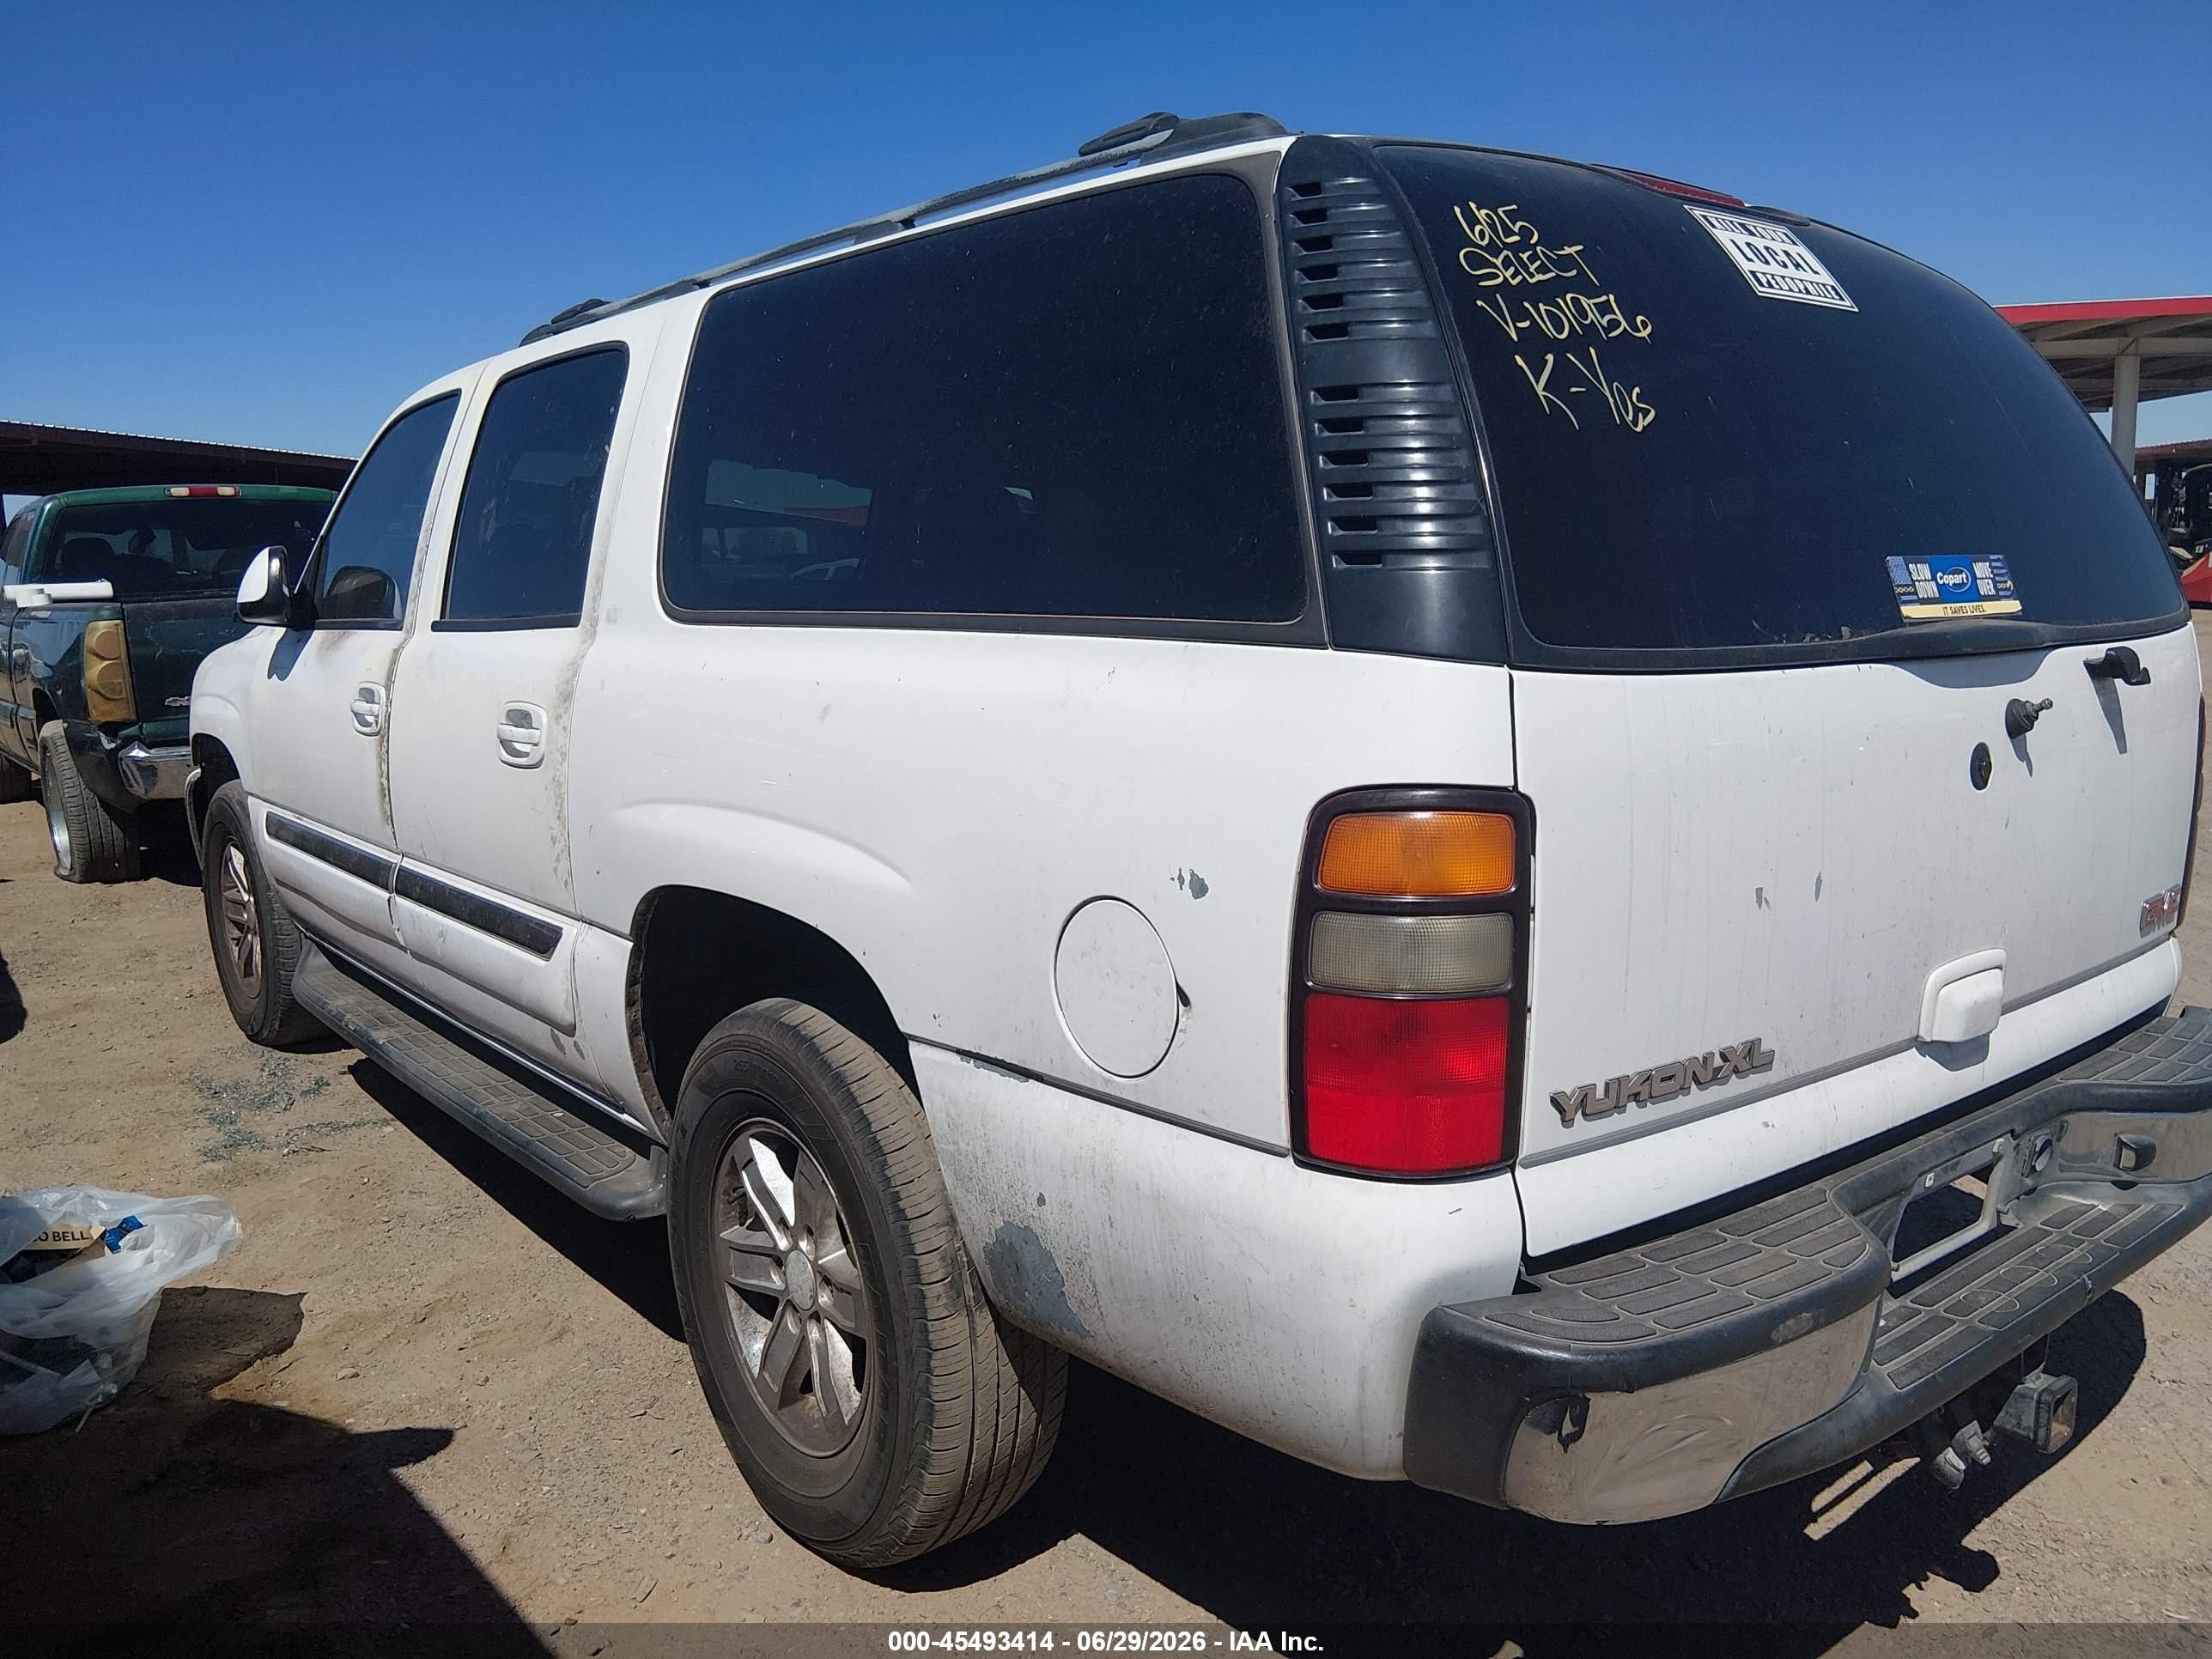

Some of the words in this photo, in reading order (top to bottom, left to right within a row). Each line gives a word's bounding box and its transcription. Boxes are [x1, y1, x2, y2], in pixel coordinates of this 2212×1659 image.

[1707, 216, 1750, 235] KILL
[1747, 223, 1796, 246] YOUR
[1459, 245, 1601, 287] SELECT
[1730, 239, 1821, 275] LOCAL
[1755, 271, 1840, 300] PEDOPHILE
[1908, 562, 1931, 580] SLOW
[1936, 571, 1967, 586] Copart
[1972, 562, 1993, 578] MOVE
[1915, 580, 1940, 599] DOWN
[1977, 579, 1996, 596] OVER
[1942, 607, 1949, 616] IT
[1948, 605, 1969, 616] SAVES
[1550, 1050, 1715, 1122] YUKON
[1717, 1037, 1775, 1079] XL
